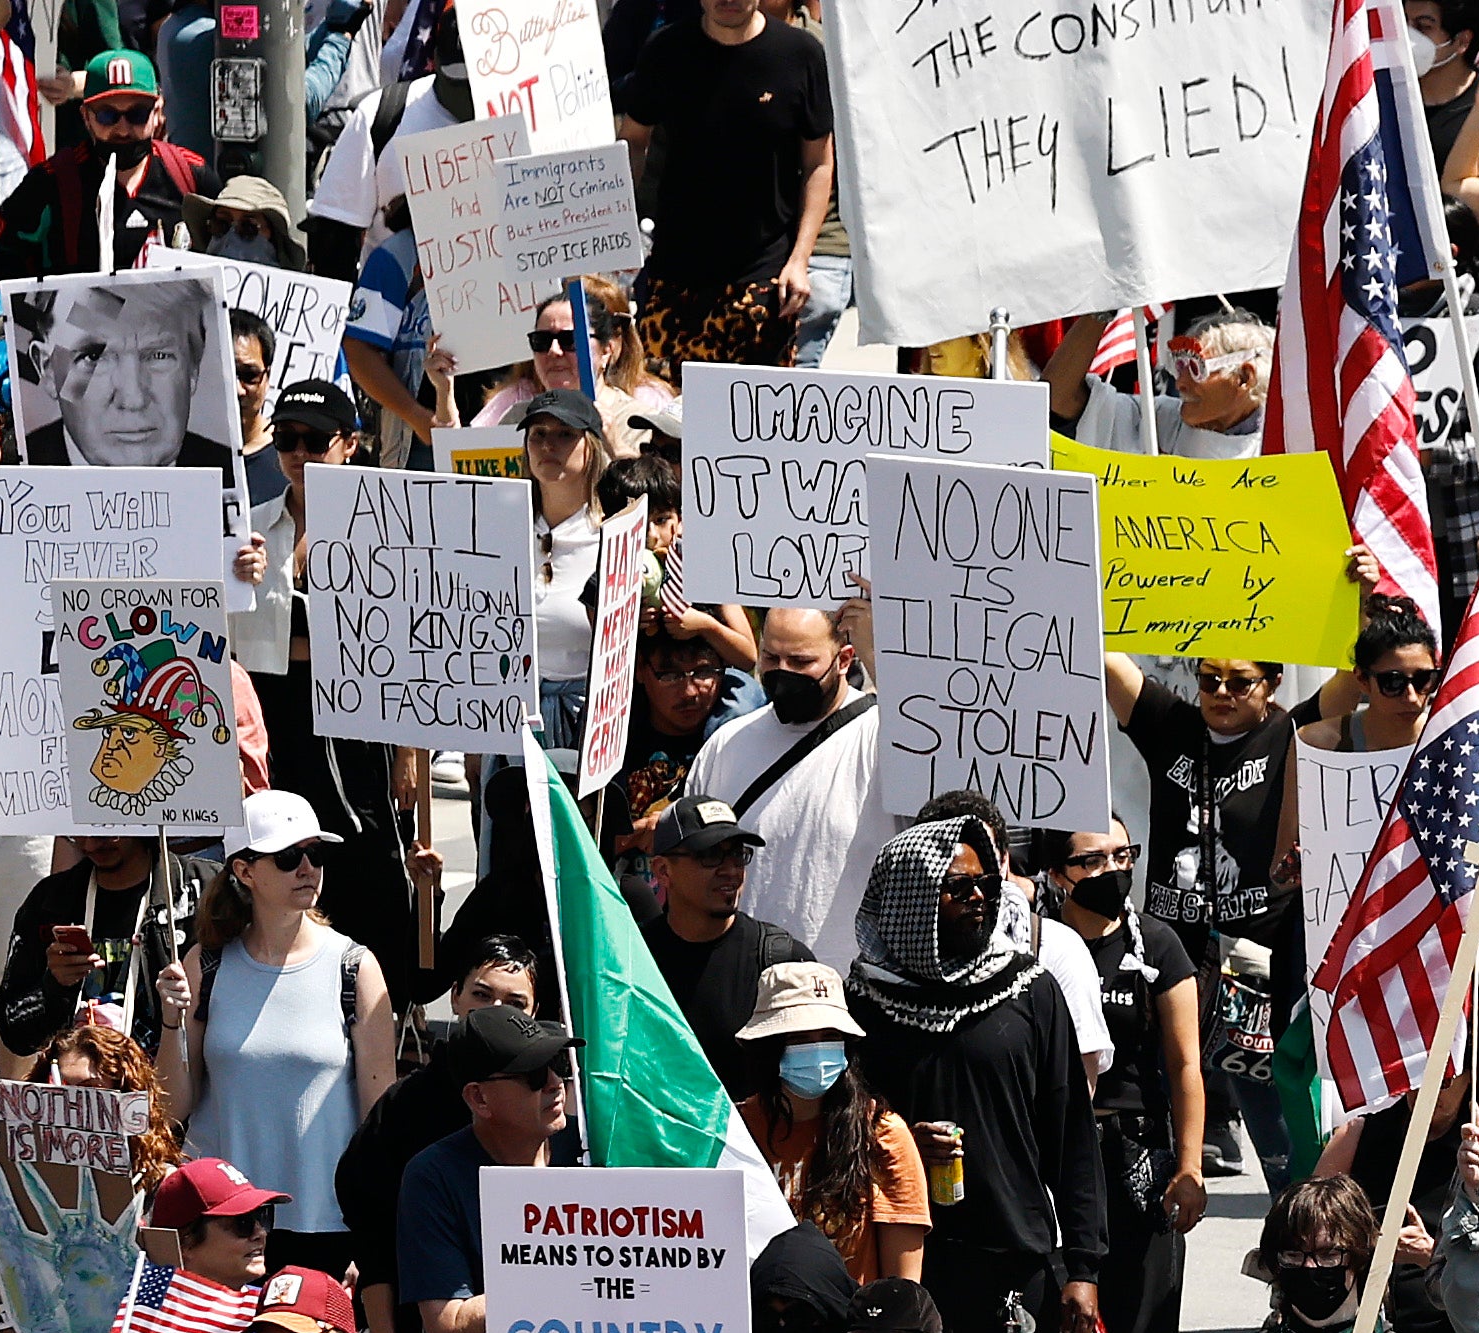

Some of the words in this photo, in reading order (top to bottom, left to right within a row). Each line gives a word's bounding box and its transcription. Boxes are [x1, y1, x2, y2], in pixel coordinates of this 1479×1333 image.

[923, 113, 1061, 212] THEY
[1106, 45, 1303, 176] LIED!
[1114, 519, 1281, 556] AMERICA
[62, 588, 93, 608] NO
[102, 588, 173, 608] CROWN
[181, 588, 220, 608] FOR
[1102, 565, 1206, 596] Powered
[1242, 576, 1274, 600] by
[1106, 595, 1274, 650] Immigrants
[162, 809, 179, 822] NO
[182, 809, 219, 823] KINGS
[520, 1202, 704, 1239] PATRIOTISM
[501, 1244, 578, 1268] MEANS
[583, 1247, 612, 1267] TO
[618, 1247, 691, 1269] STAND
[692, 1247, 725, 1270] BY
